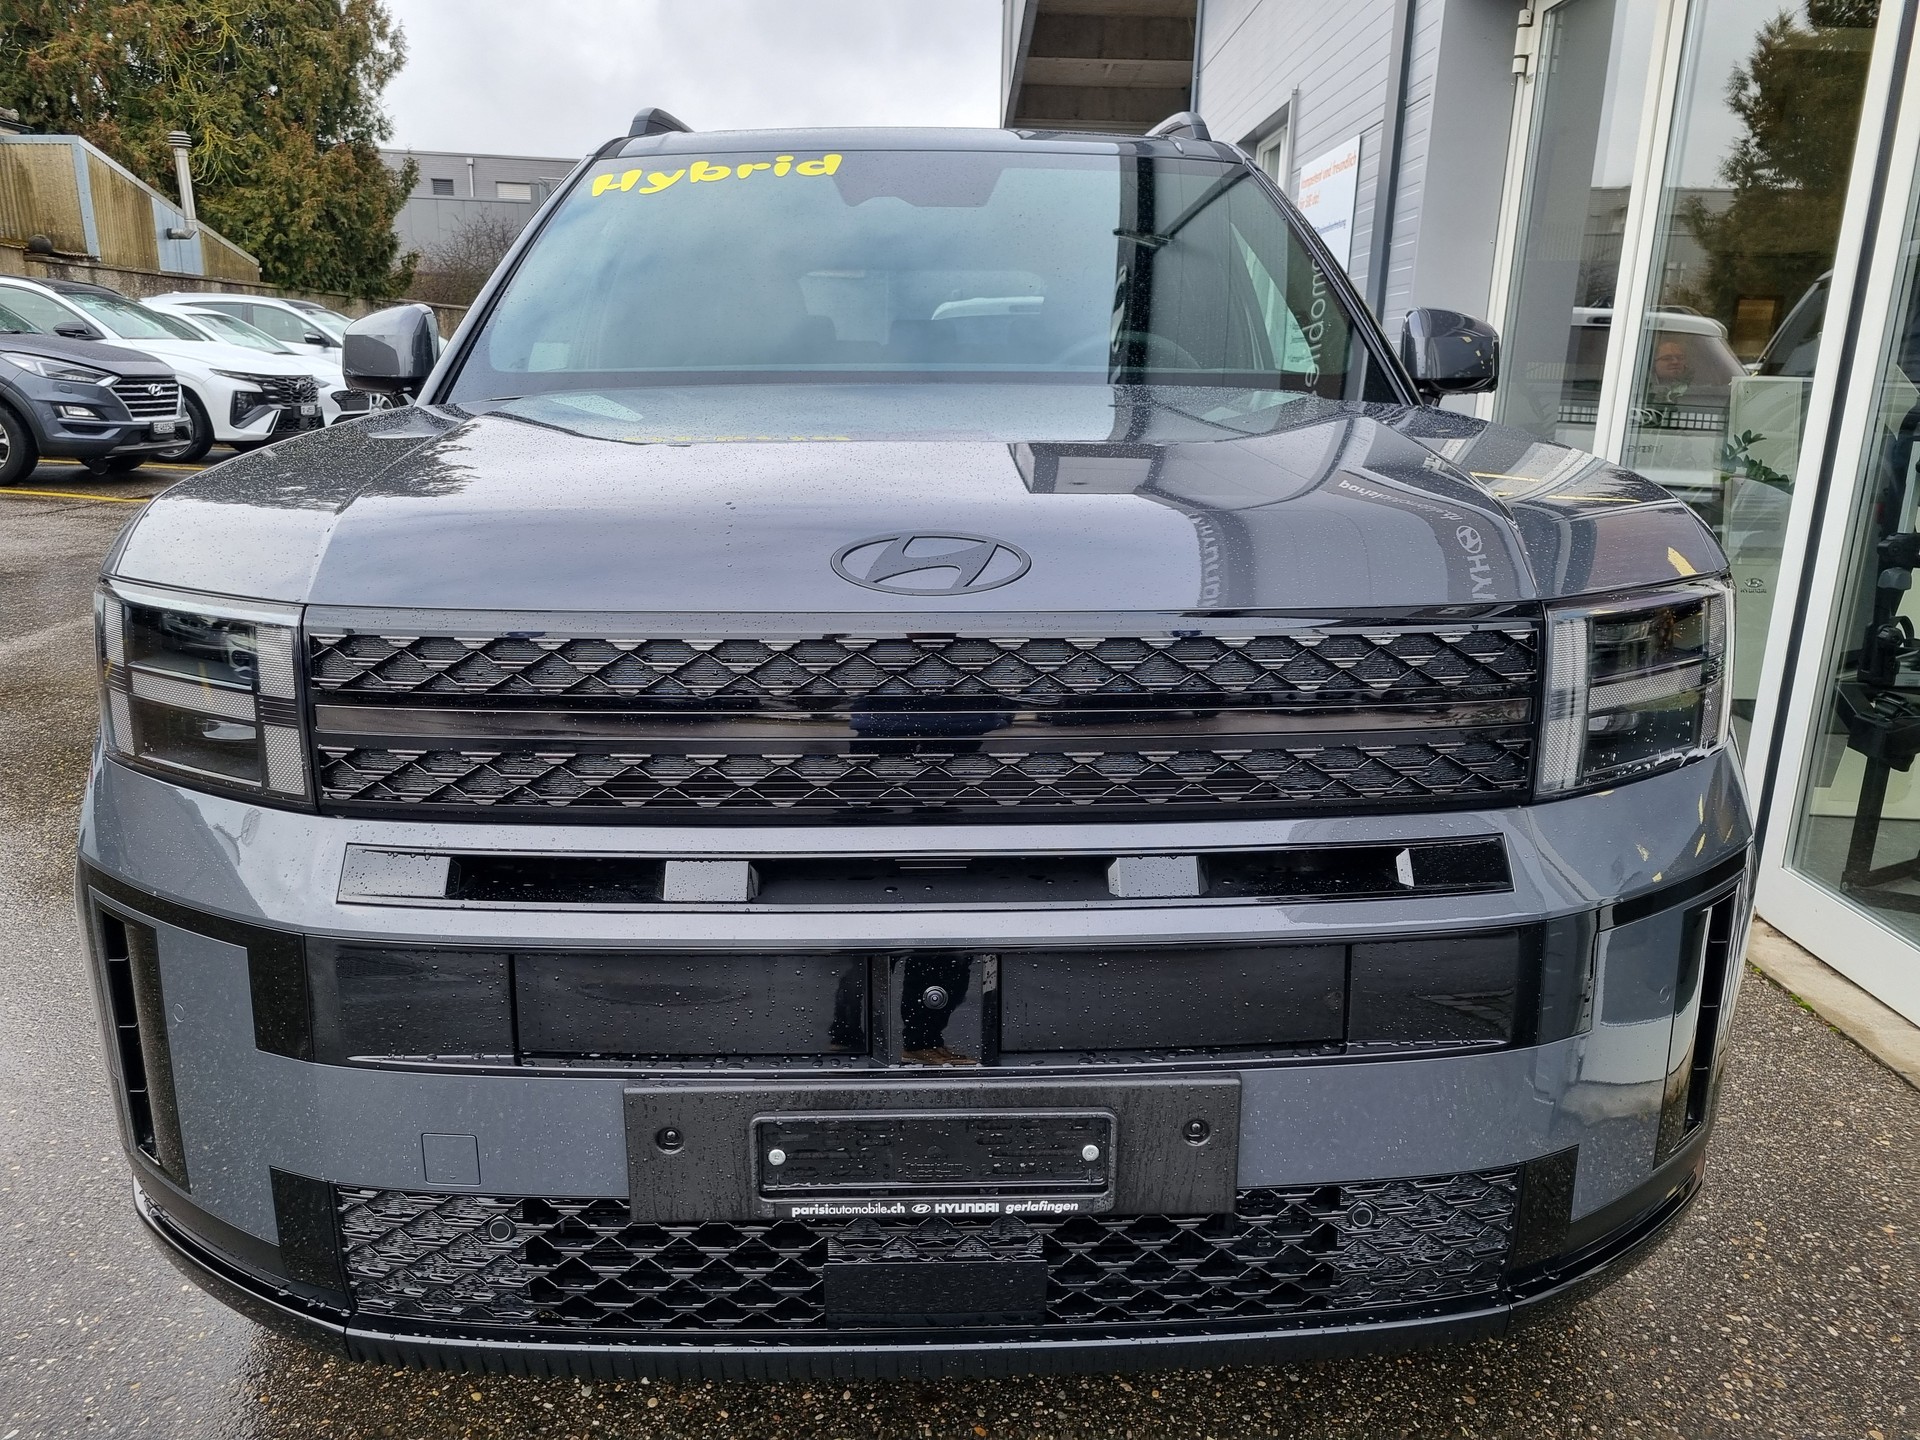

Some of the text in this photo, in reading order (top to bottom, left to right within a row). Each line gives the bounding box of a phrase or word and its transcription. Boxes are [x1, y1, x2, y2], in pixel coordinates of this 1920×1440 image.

[592, 154, 842, 197] Hybrid
[791, 1201, 1079, 1218] parisiautomobile.ch HYUNDAI gerlafingen
